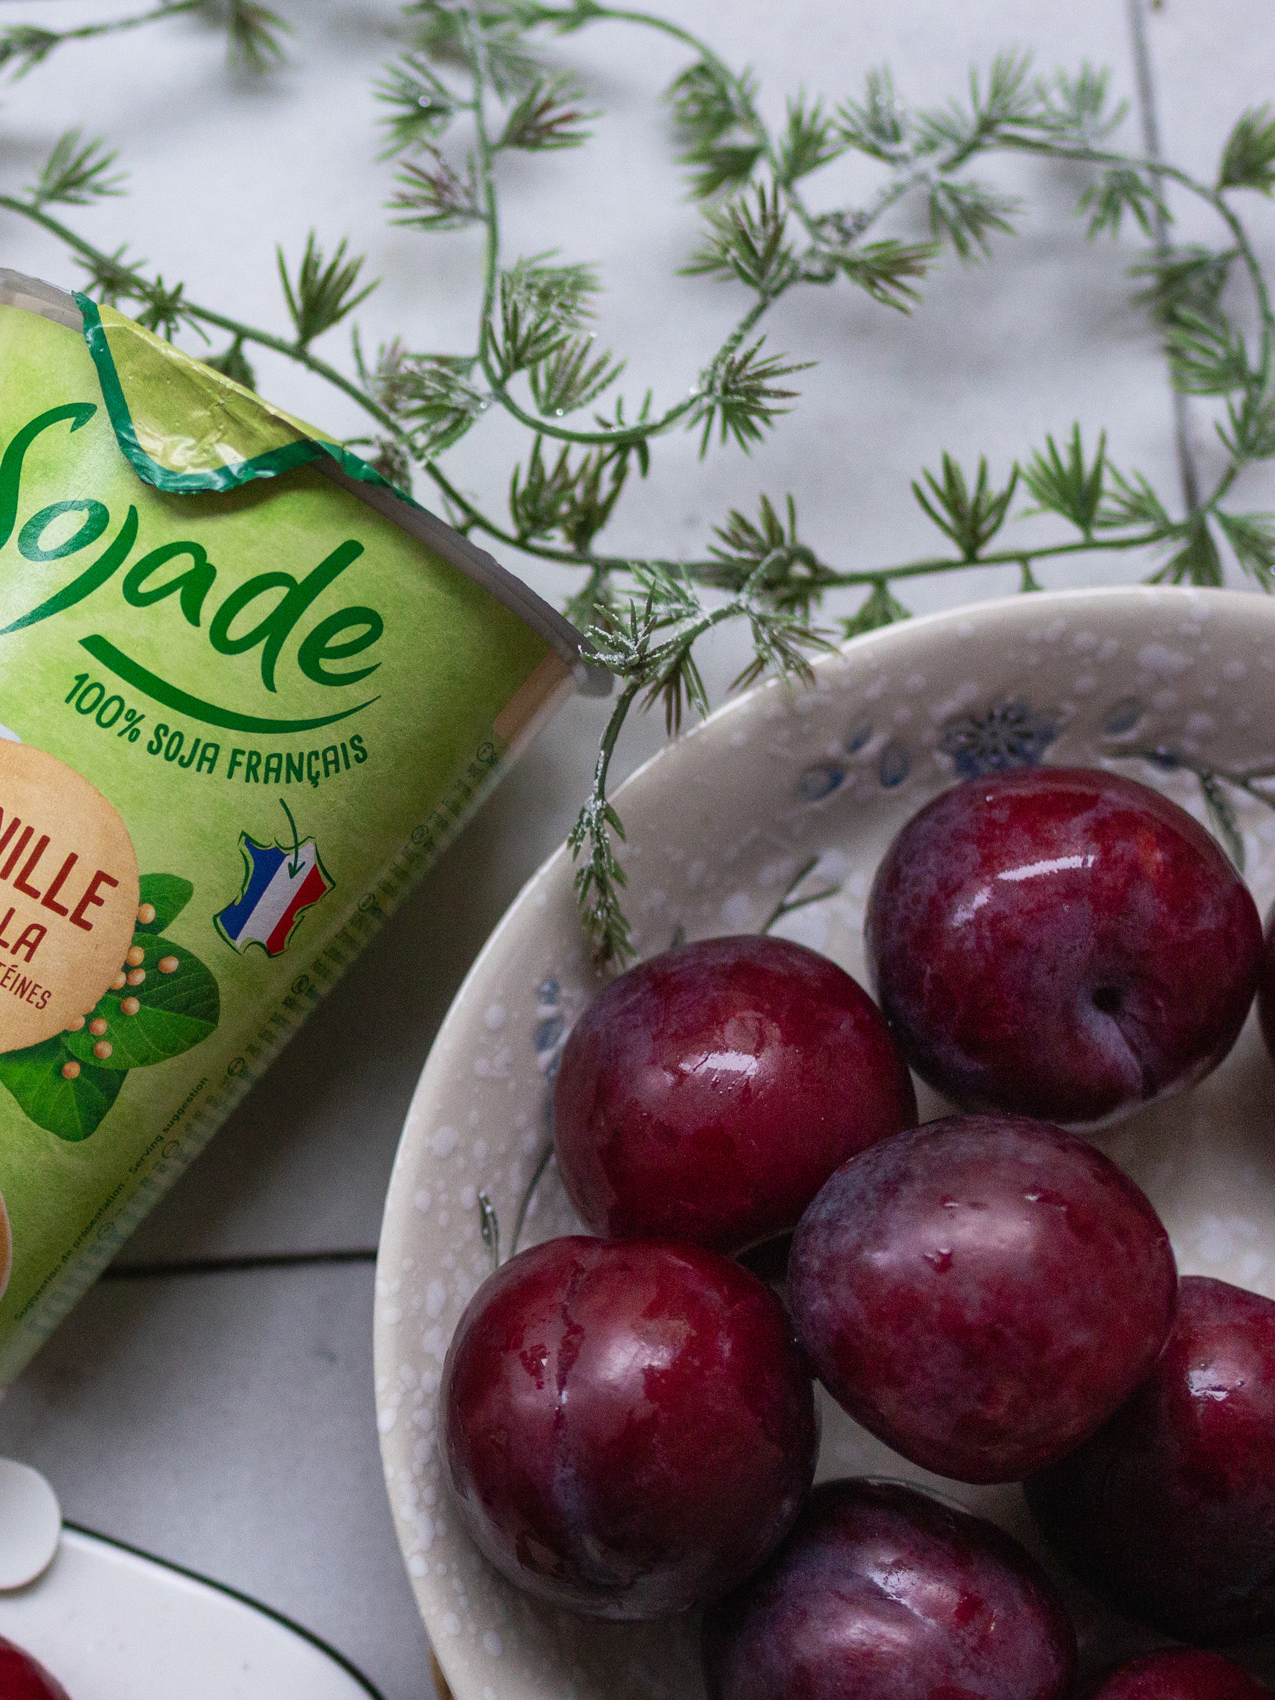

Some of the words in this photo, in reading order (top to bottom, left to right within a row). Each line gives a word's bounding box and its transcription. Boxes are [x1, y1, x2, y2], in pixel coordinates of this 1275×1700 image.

[65, 673, 145, 743] 100%
[147, 722, 220, 775] SOJA
[227, 734, 369, 788] FRANÇAIS
[14, 1265, 62, 1321] Suggestion
[128, 1134, 165, 1175] Serving
[163, 1076, 209, 1134] suggestion
